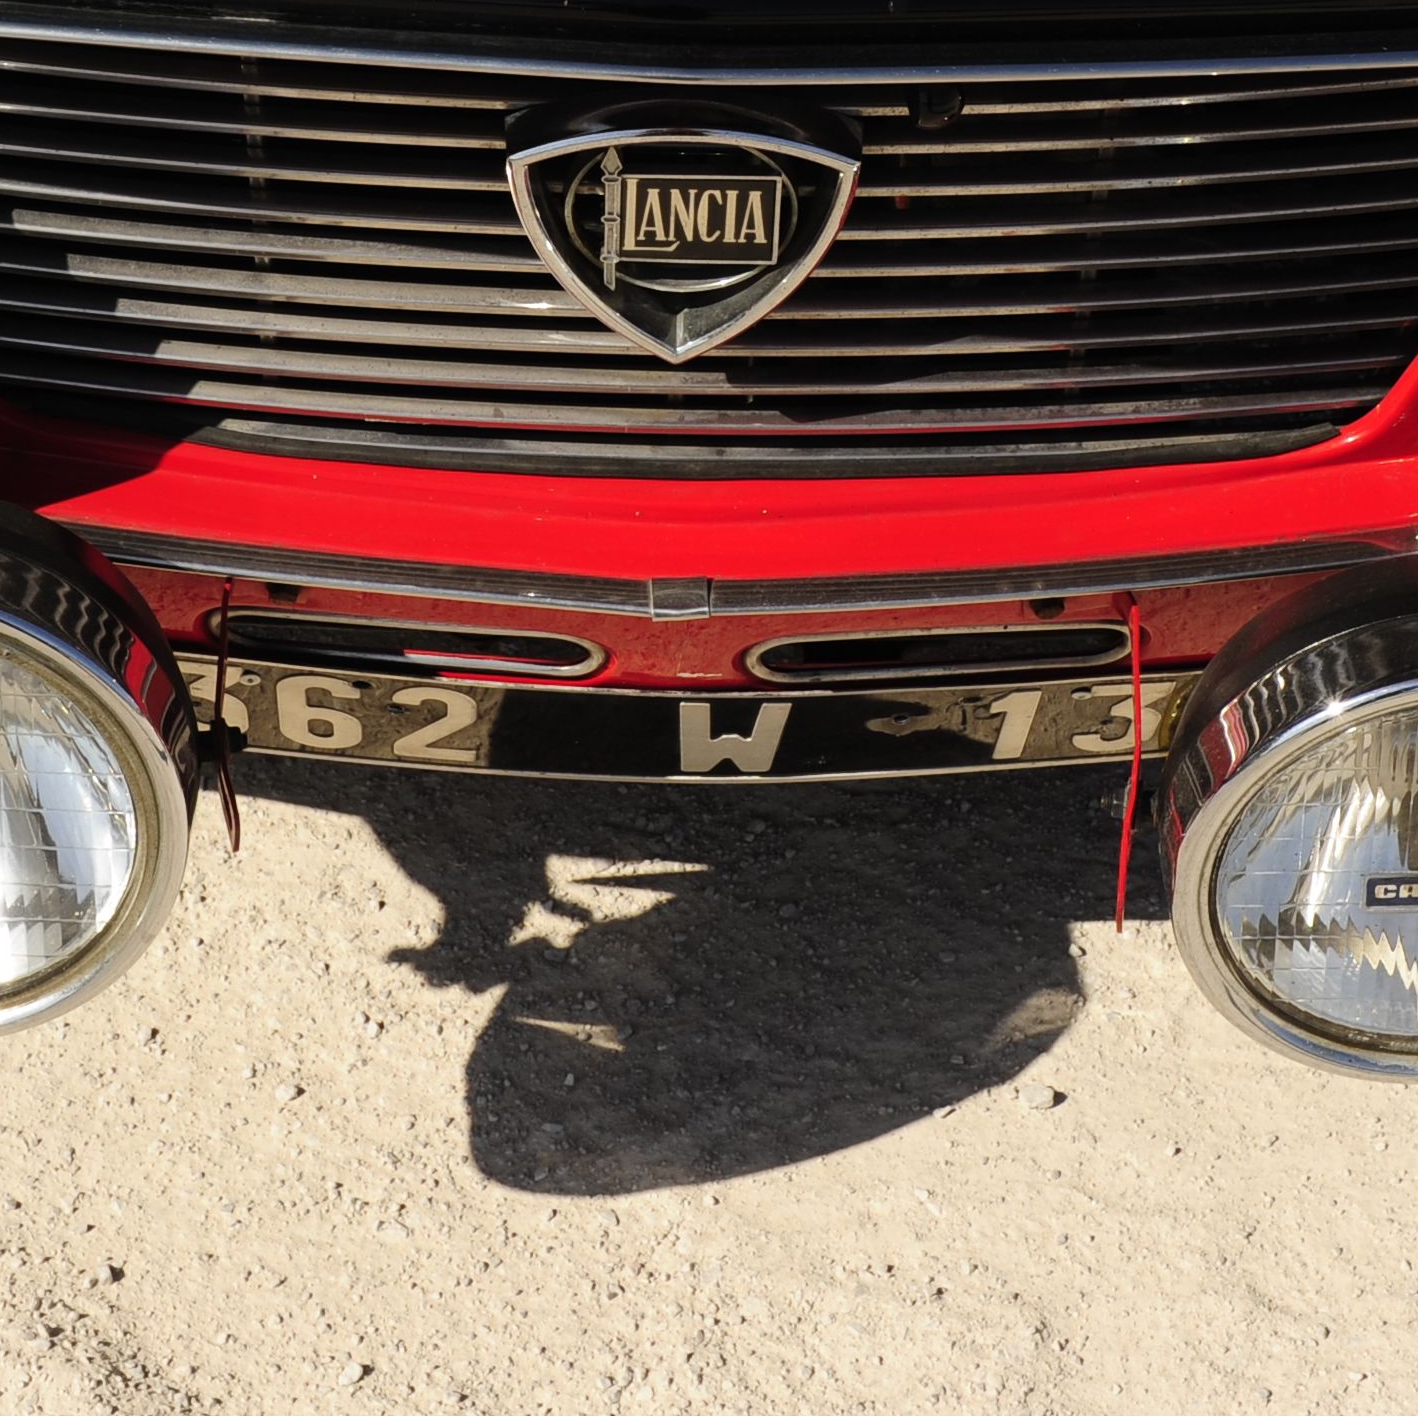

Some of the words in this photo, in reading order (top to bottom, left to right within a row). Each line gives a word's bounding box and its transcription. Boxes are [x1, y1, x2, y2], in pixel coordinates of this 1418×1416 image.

[621, 177, 768, 252] LANCIA
[680, 702, 792, 772] W
[991, 681, 1176, 760] 13
